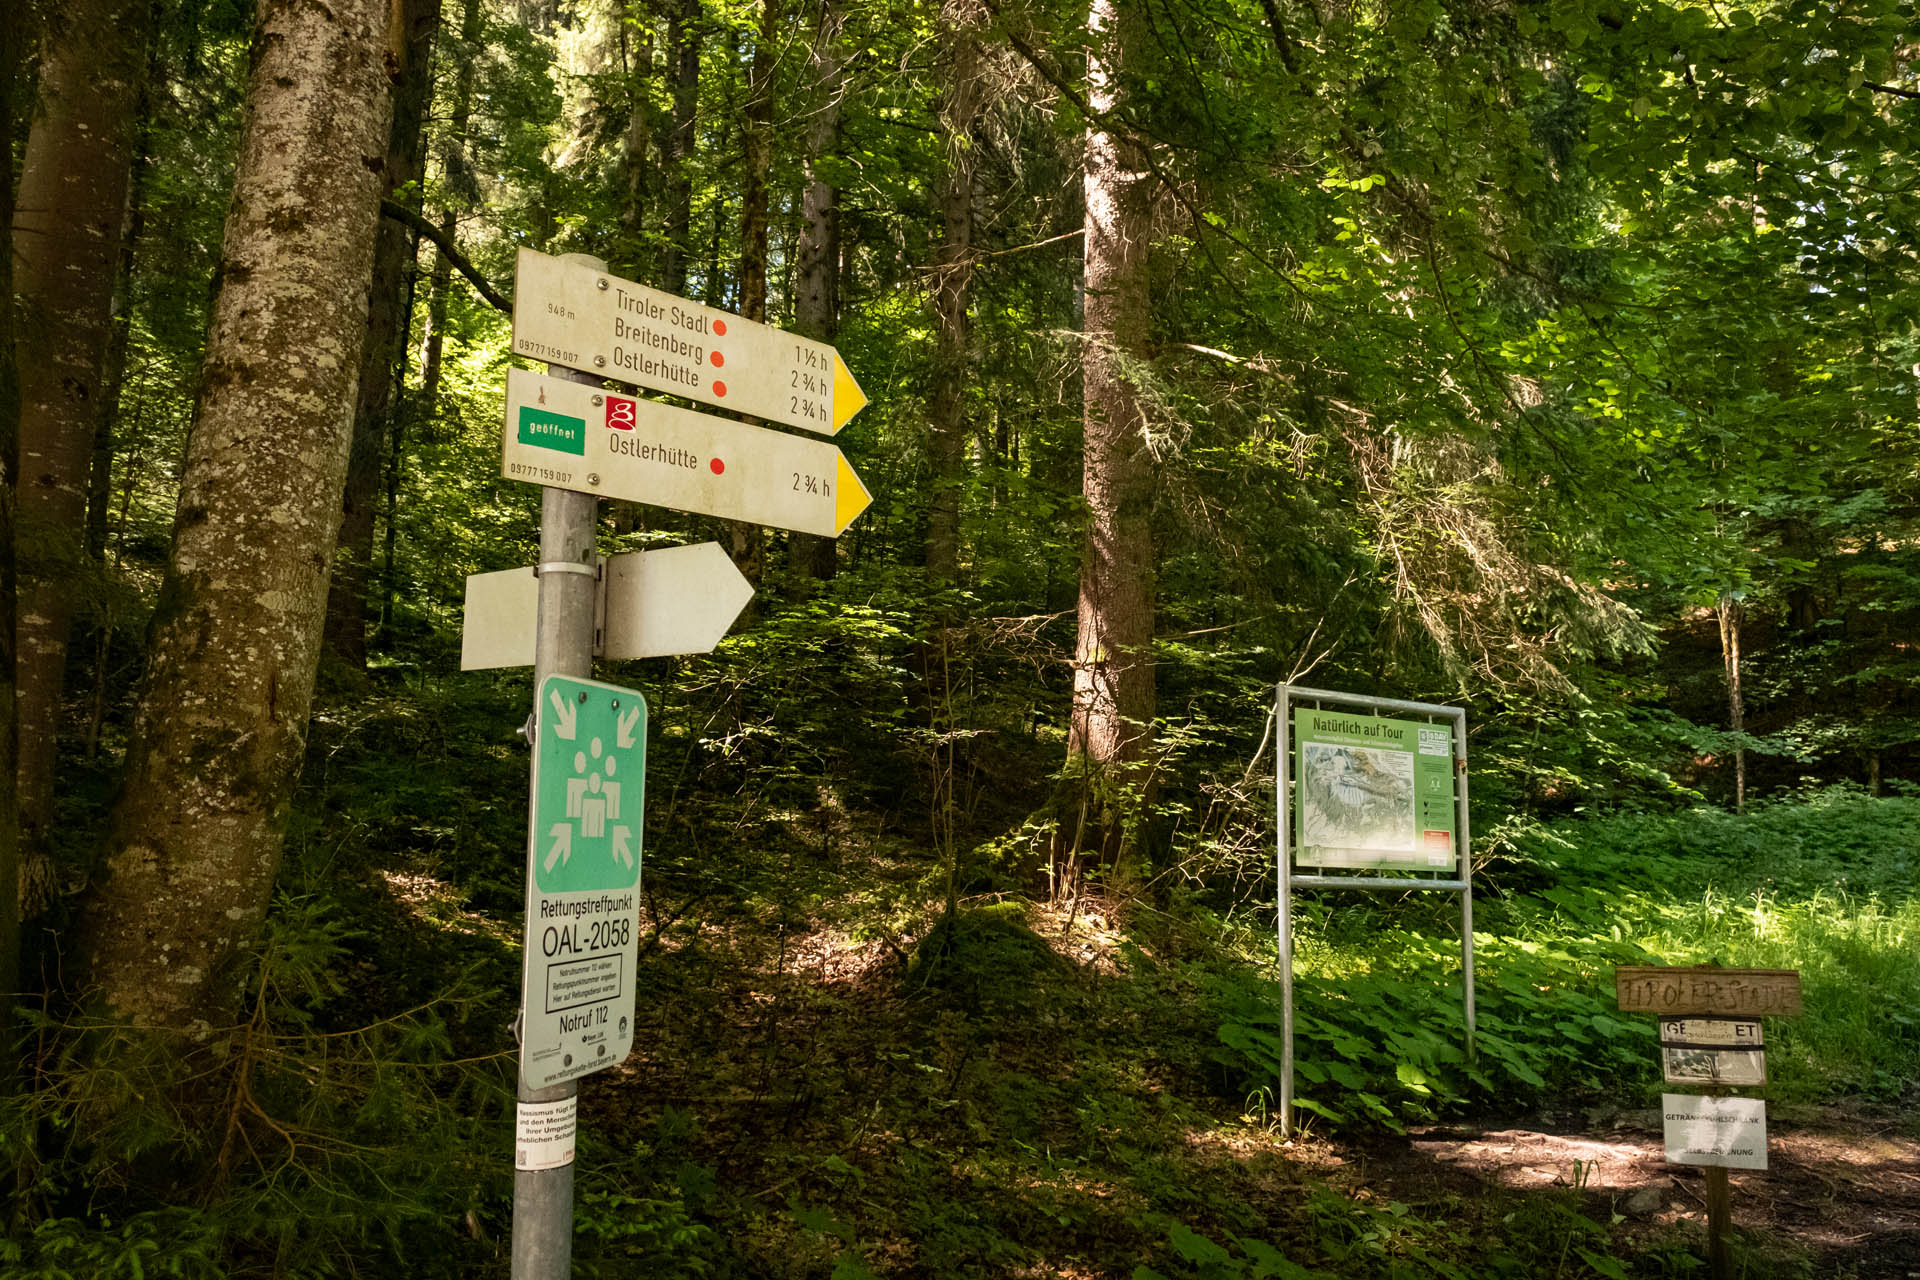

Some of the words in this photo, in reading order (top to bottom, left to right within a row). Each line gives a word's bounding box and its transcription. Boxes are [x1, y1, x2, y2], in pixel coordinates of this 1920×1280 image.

[548, 303, 565, 317] 948
[567, 311, 575, 320] m
[616, 288, 665, 321] Tiroler
[671, 306, 709, 335] Stadl
[796, 345, 800, 363] 1
[820, 353, 828, 371] h
[519, 339, 545, 354] 09777
[547, 347, 561, 359] 159
[563, 352, 578, 364] 007
[615, 317, 703, 366] Breitenberg
[791, 370, 798, 388] 2
[820, 378, 827, 396] h
[613, 346, 699, 387] Ostlerhütte
[791, 395, 798, 414] 2
[819, 403, 827, 422] h
[529, 422, 575, 440] geöffnet
[511, 463, 537, 476] 09777
[540, 468, 554, 480] 159
[556, 472, 572, 483] 007
[610, 433, 697, 469] Ostlerhütte
[792, 472, 799, 491] 2
[823, 479, 830, 497] h
[1313, 717, 1361, 735] Natürlich
[1364, 723, 1380, 737] auf
[1382, 725, 1404, 739] Tour
[541, 894, 632, 919] Rettungstreffpunkt
[542, 918, 630, 957] OAL-2058
[560, 1009, 592, 1034] Notruf
[596, 1005, 608, 1025] 112
